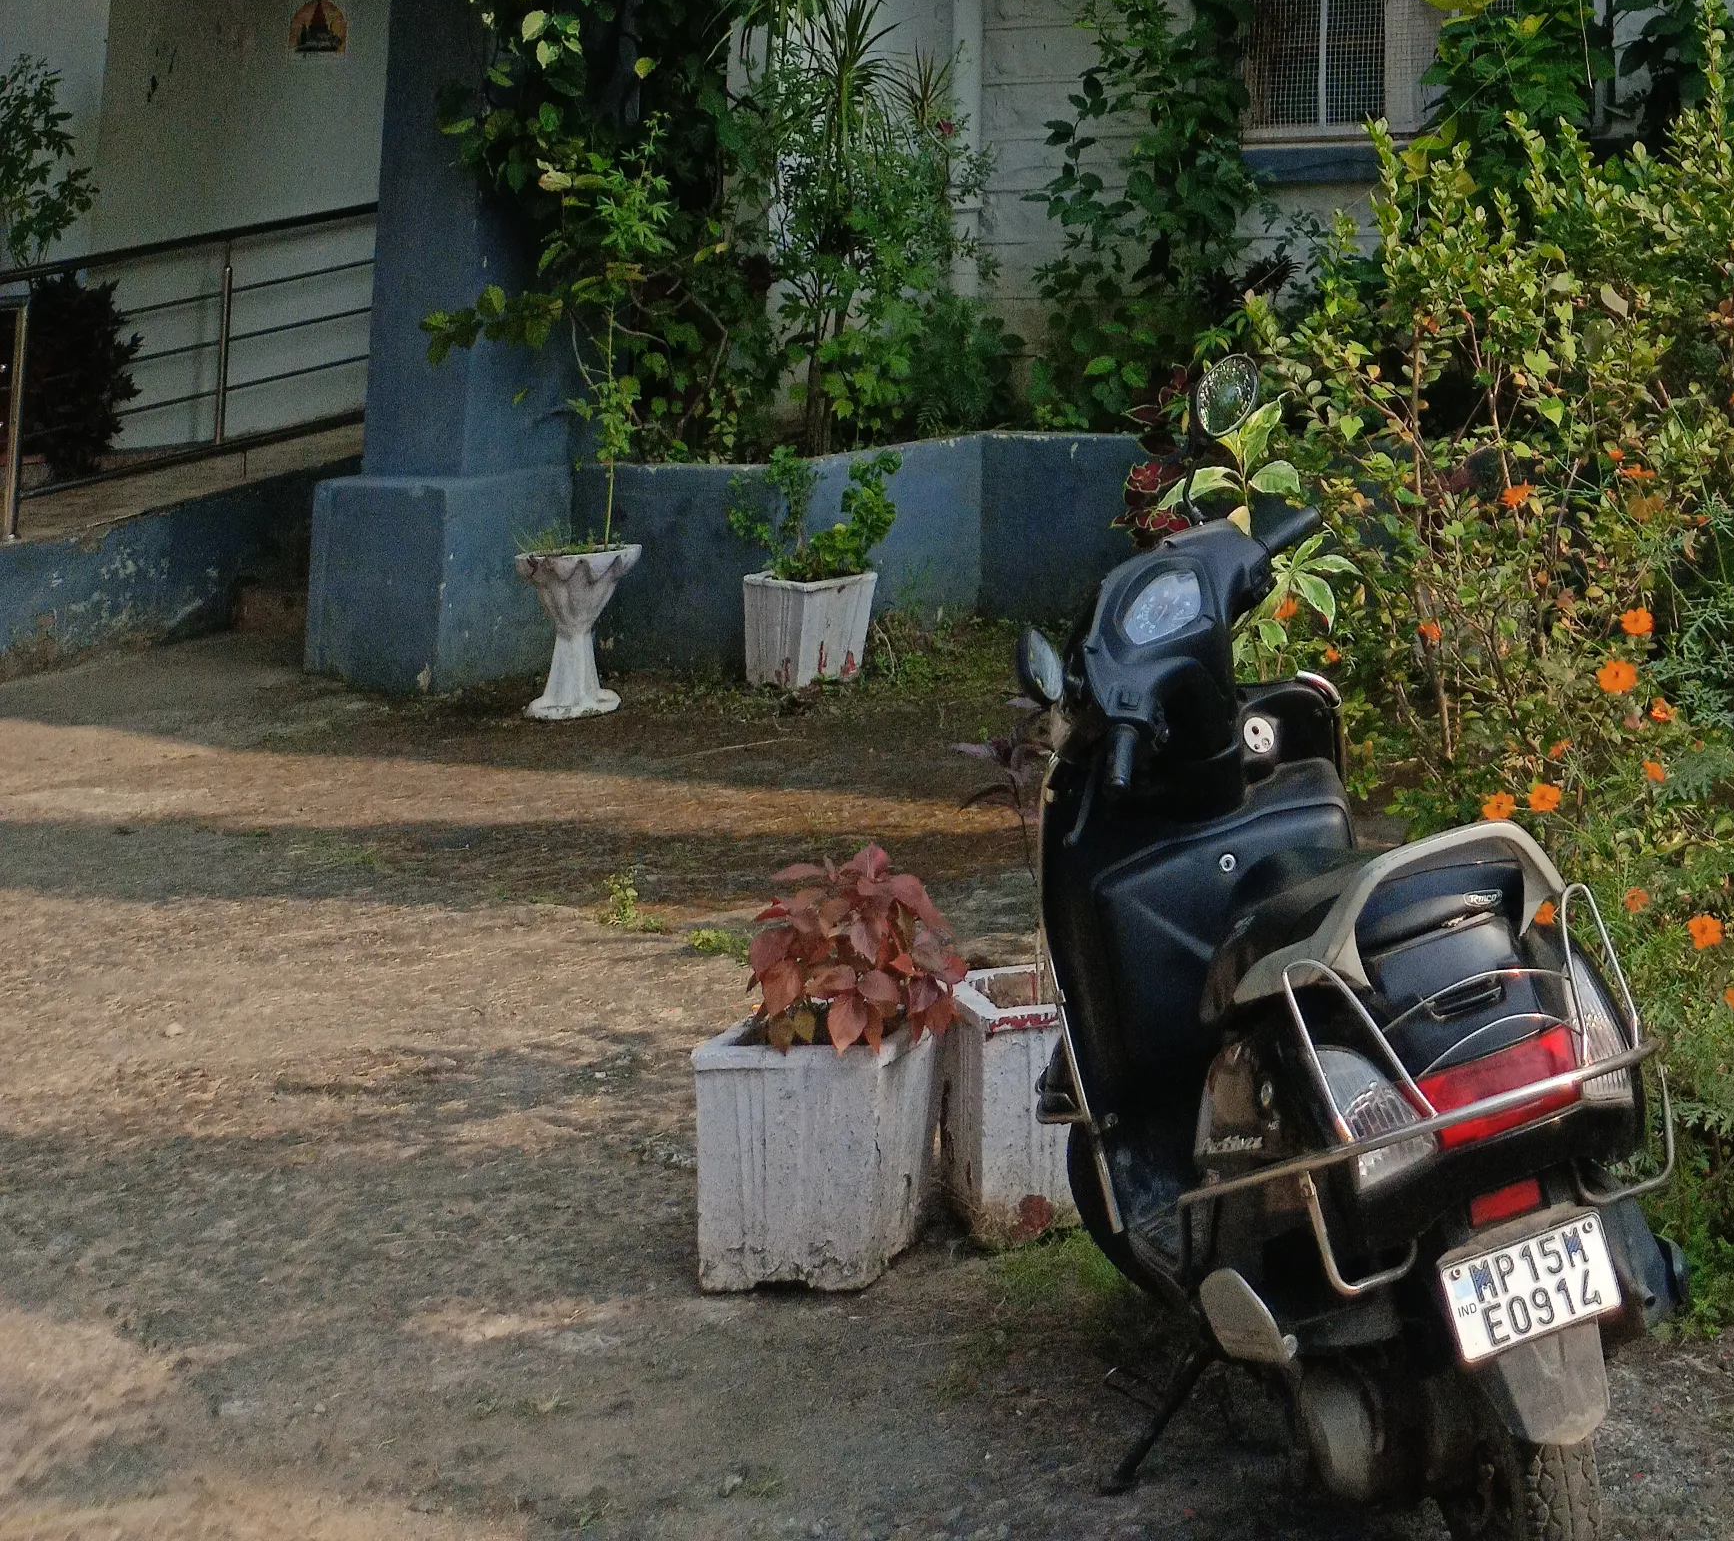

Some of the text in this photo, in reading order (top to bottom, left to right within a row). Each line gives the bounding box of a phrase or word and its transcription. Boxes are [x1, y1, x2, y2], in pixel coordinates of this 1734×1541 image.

[1468, 1226, 1589, 1304] MP15M
[1457, 1302, 1478, 1318] IND
[1481, 1268, 1602, 1347] E0914
